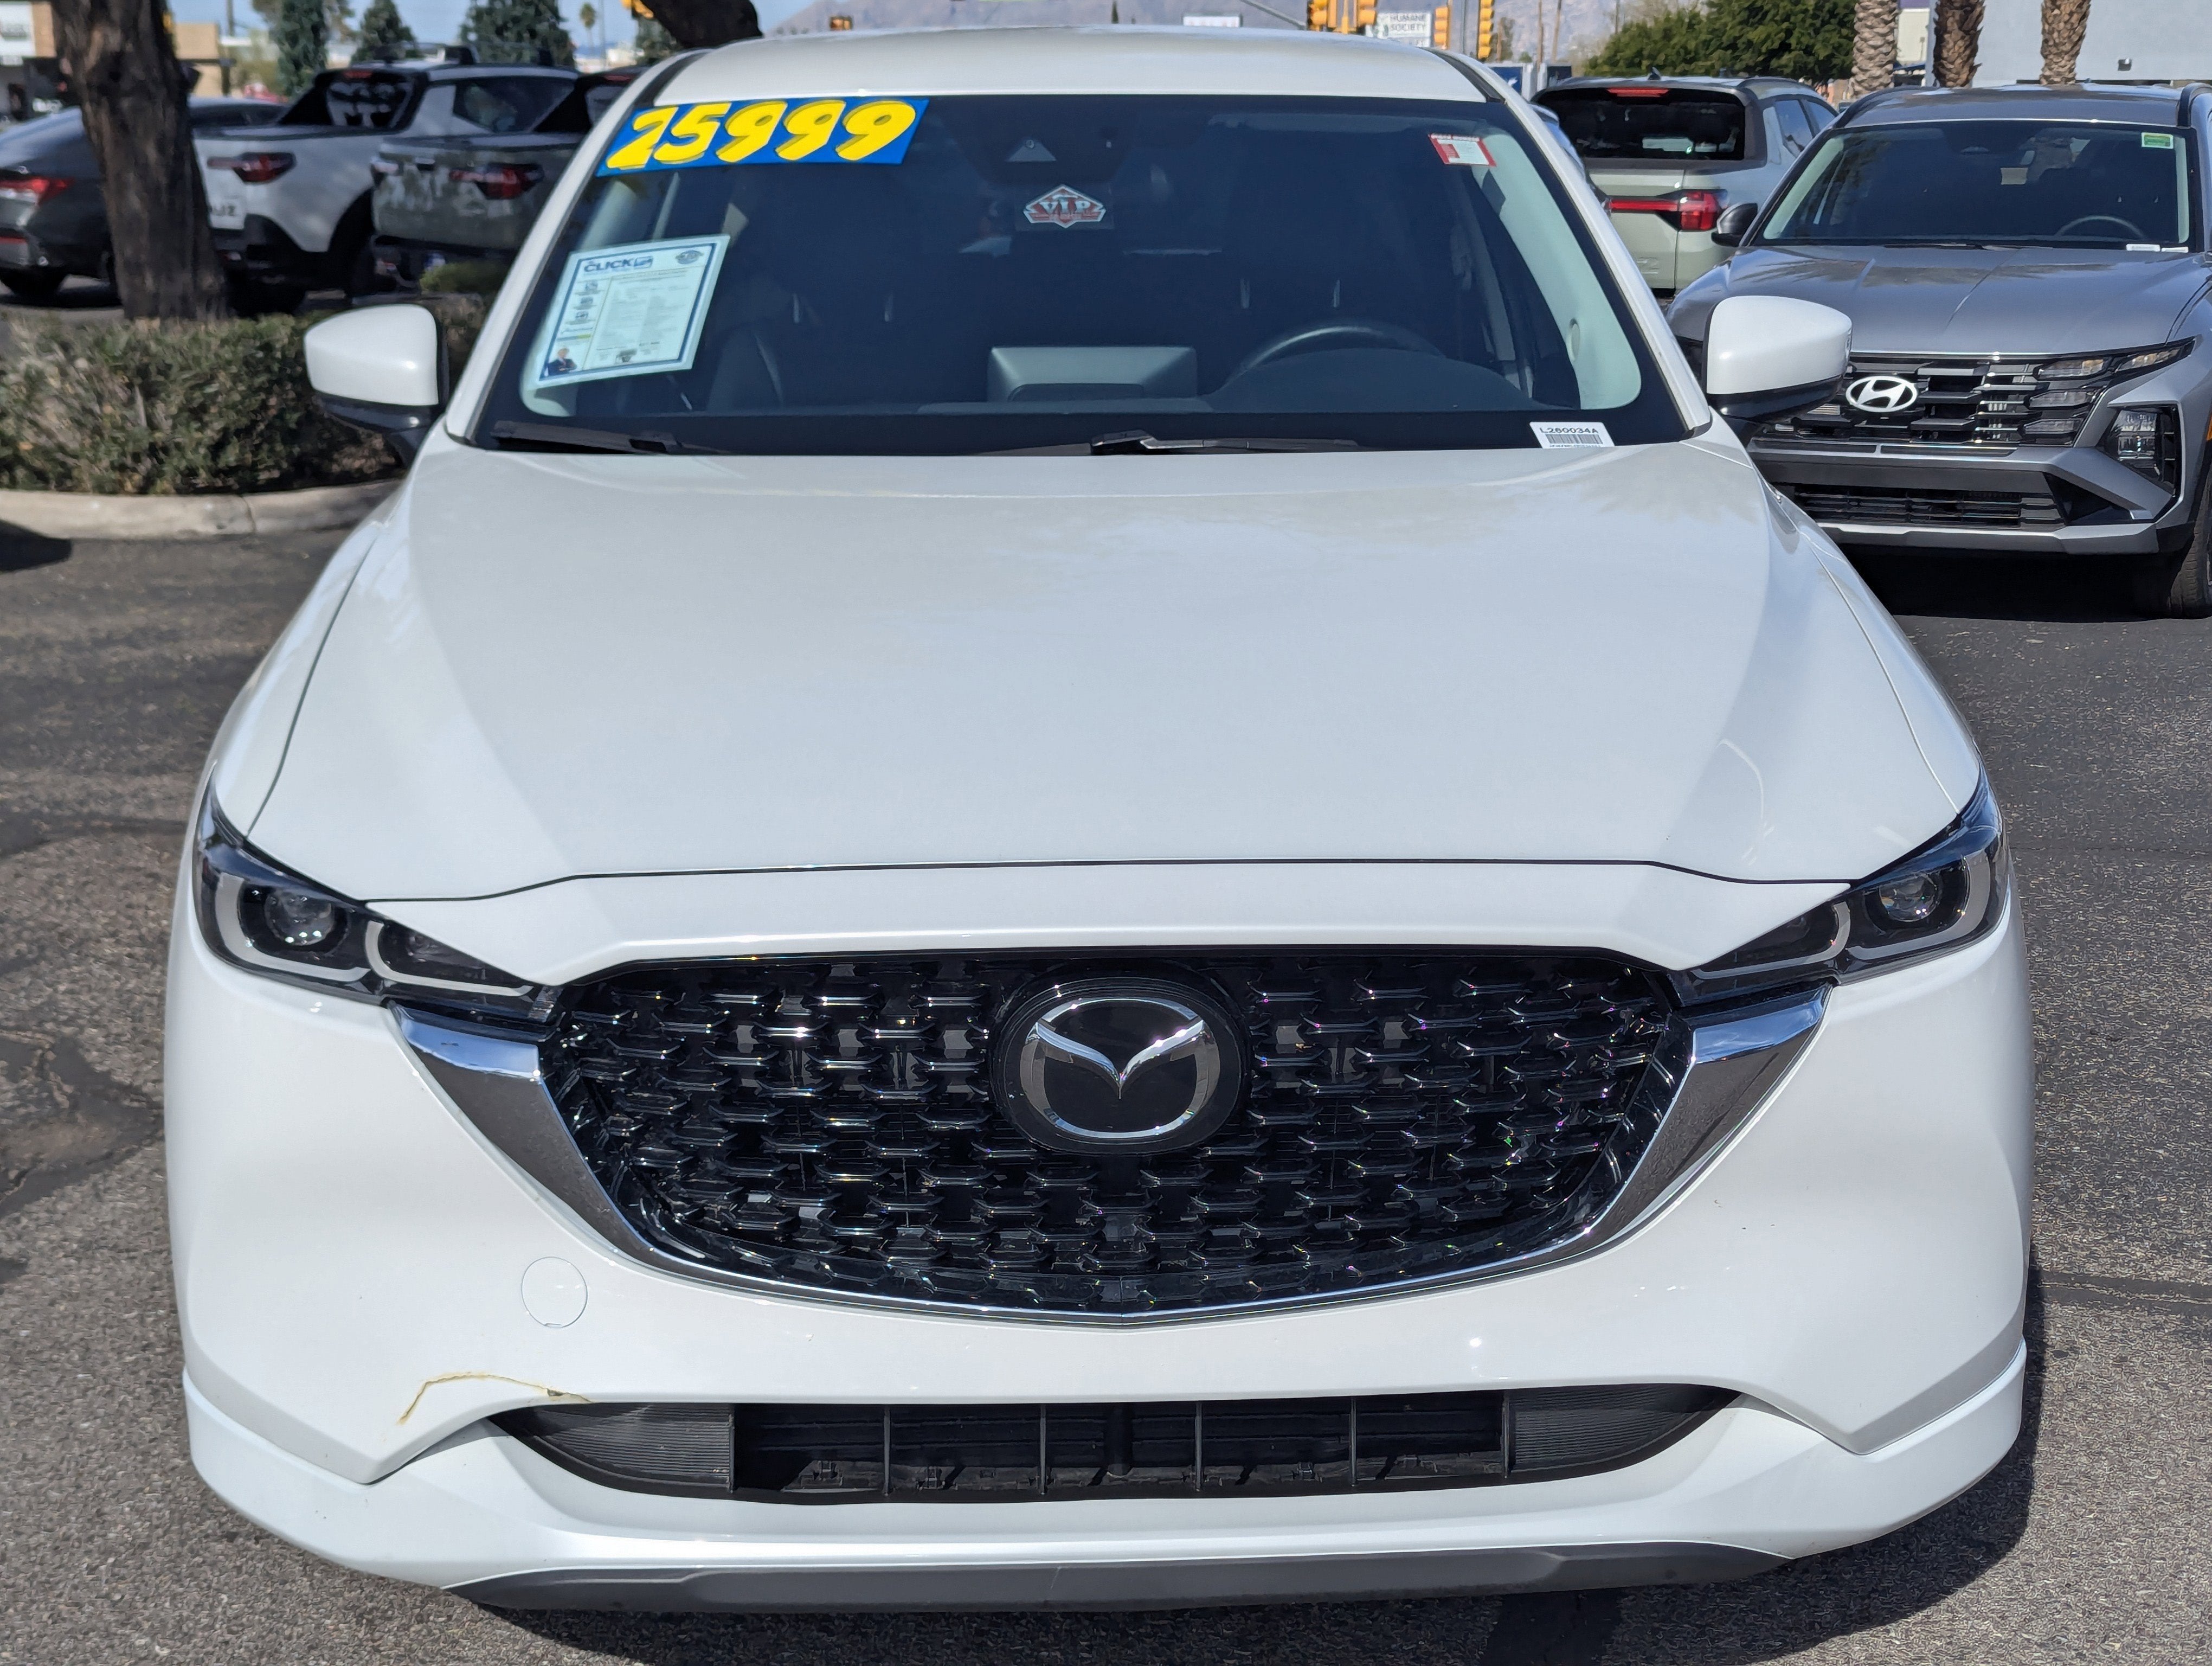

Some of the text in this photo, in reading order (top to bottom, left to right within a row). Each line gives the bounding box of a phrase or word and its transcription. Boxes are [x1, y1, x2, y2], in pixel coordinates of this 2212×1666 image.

[1390, 23, 1425, 31] SOCIETY
[606, 99, 916, 171] 25999
[1039, 194, 1091, 215] VIP
[583, 258, 634, 272] CLICK
